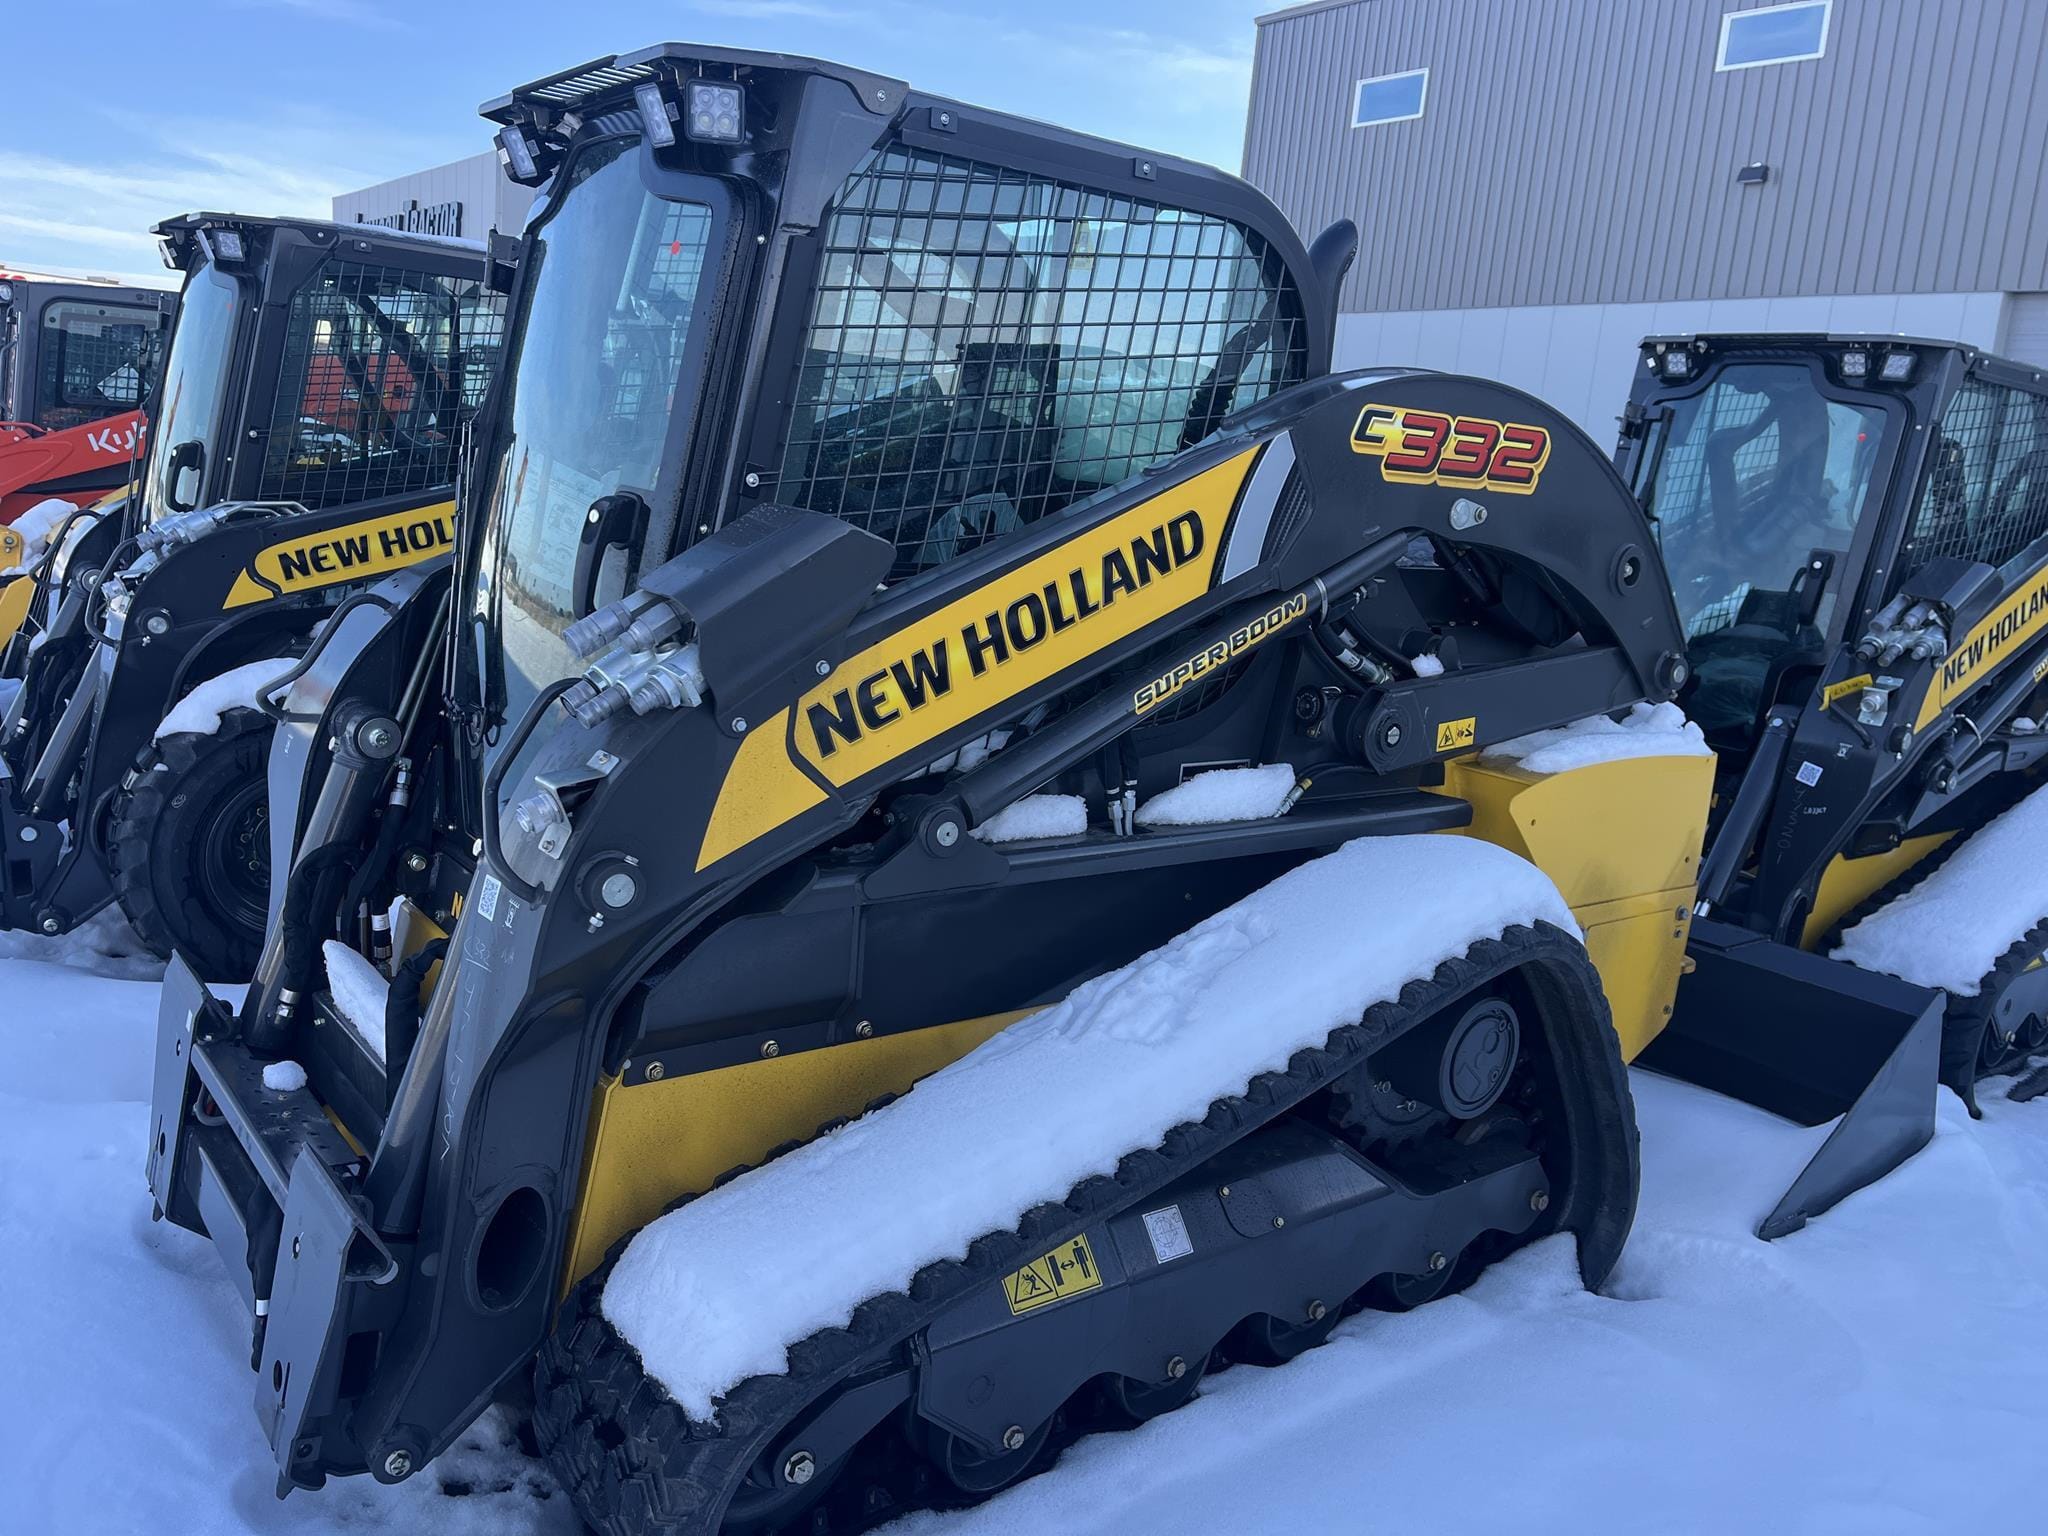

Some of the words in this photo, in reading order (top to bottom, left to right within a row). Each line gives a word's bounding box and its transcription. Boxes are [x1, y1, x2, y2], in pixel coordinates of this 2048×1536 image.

[1352, 404, 1550, 494] C332
[277, 534, 371, 581] NEW
[378, 514, 457, 558] HOL
[807, 638, 952, 759] NEW
[961, 510, 1204, 677] HOLLAND
[1134, 641, 1228, 714] SUPER
[1230, 593, 1307, 656] BOOM
[1943, 635, 1985, 691] NEW
